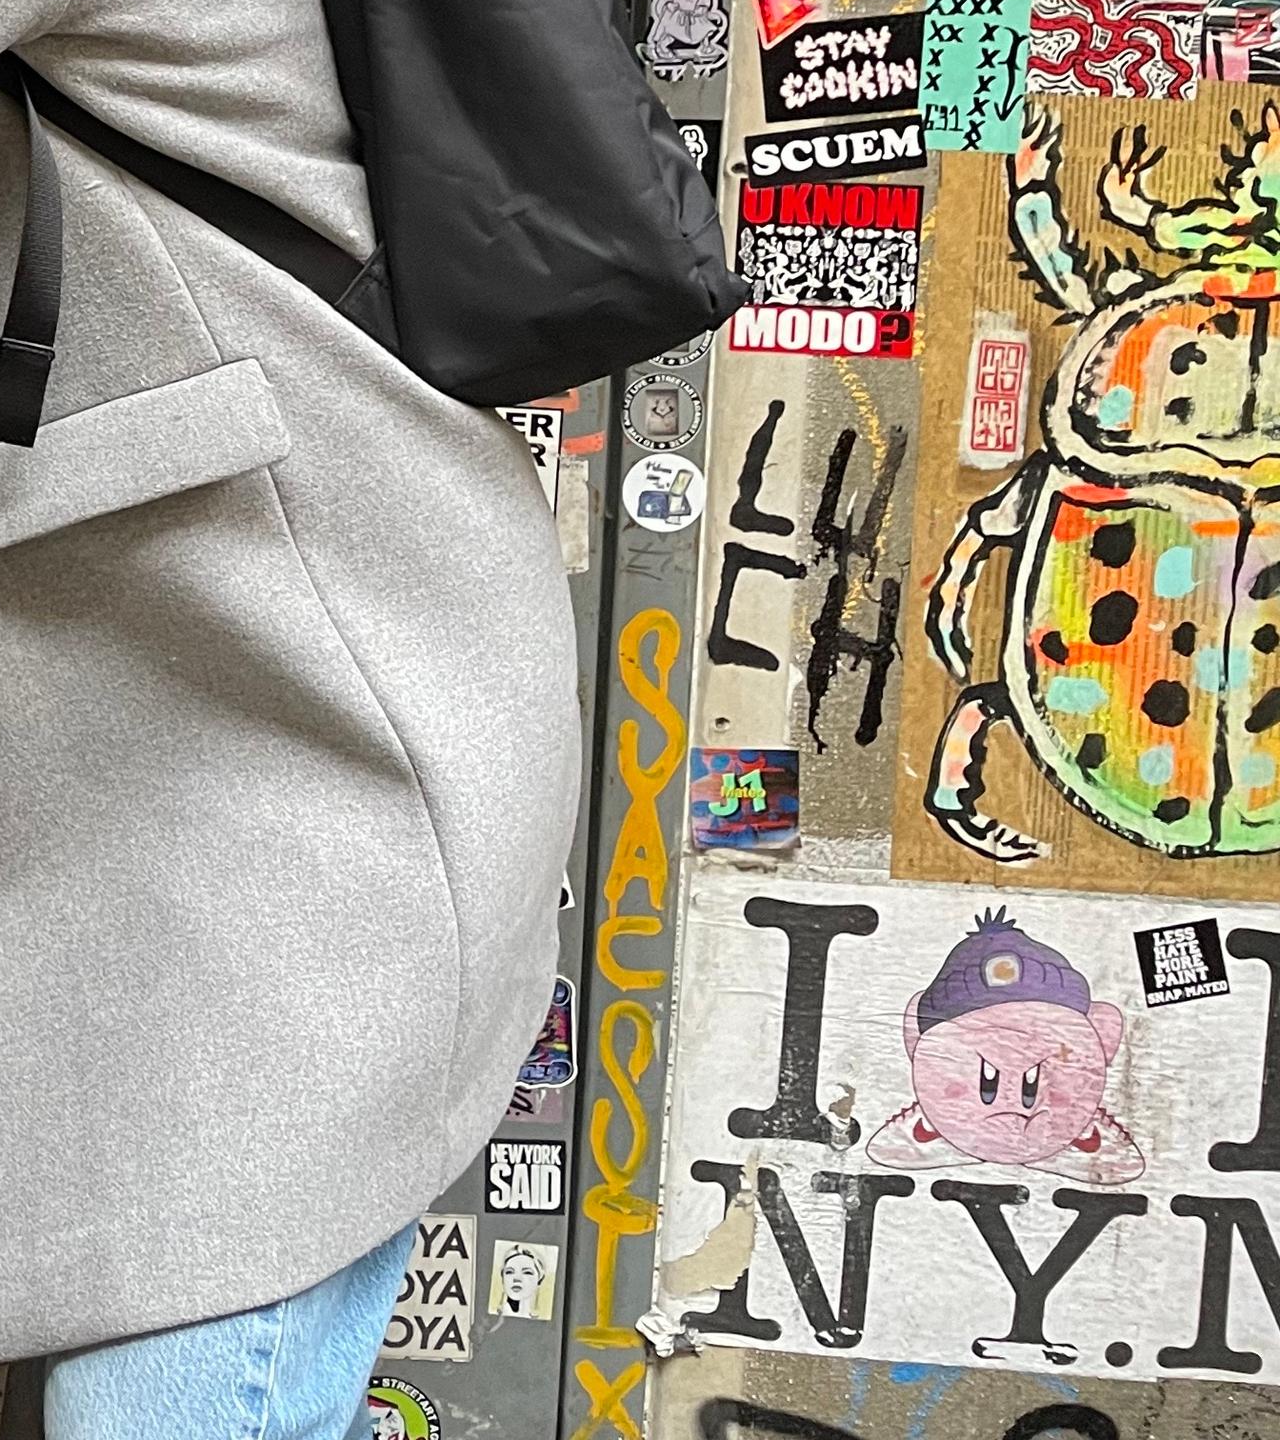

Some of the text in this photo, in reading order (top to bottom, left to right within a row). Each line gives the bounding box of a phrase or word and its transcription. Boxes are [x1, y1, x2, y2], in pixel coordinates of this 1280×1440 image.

[793, 24, 892, 63] STAY
[779, 55, 918, 110] COOKIN
[752, 126, 922, 175] SCUEM
[744, 186, 918, 227] U KNOW
[737, 308, 912, 355] MODO?
[1153, 927, 1195, 947] LESS
[1154, 940, 1201, 960] HATE
[1156, 955, 1204, 975] MORE
[1157, 969, 1209, 989] PAINT
[1147, 988, 1181, 1005] SNAP
[727, 897, 878, 1144] I
[490, 1164, 562, 1211] SAID
